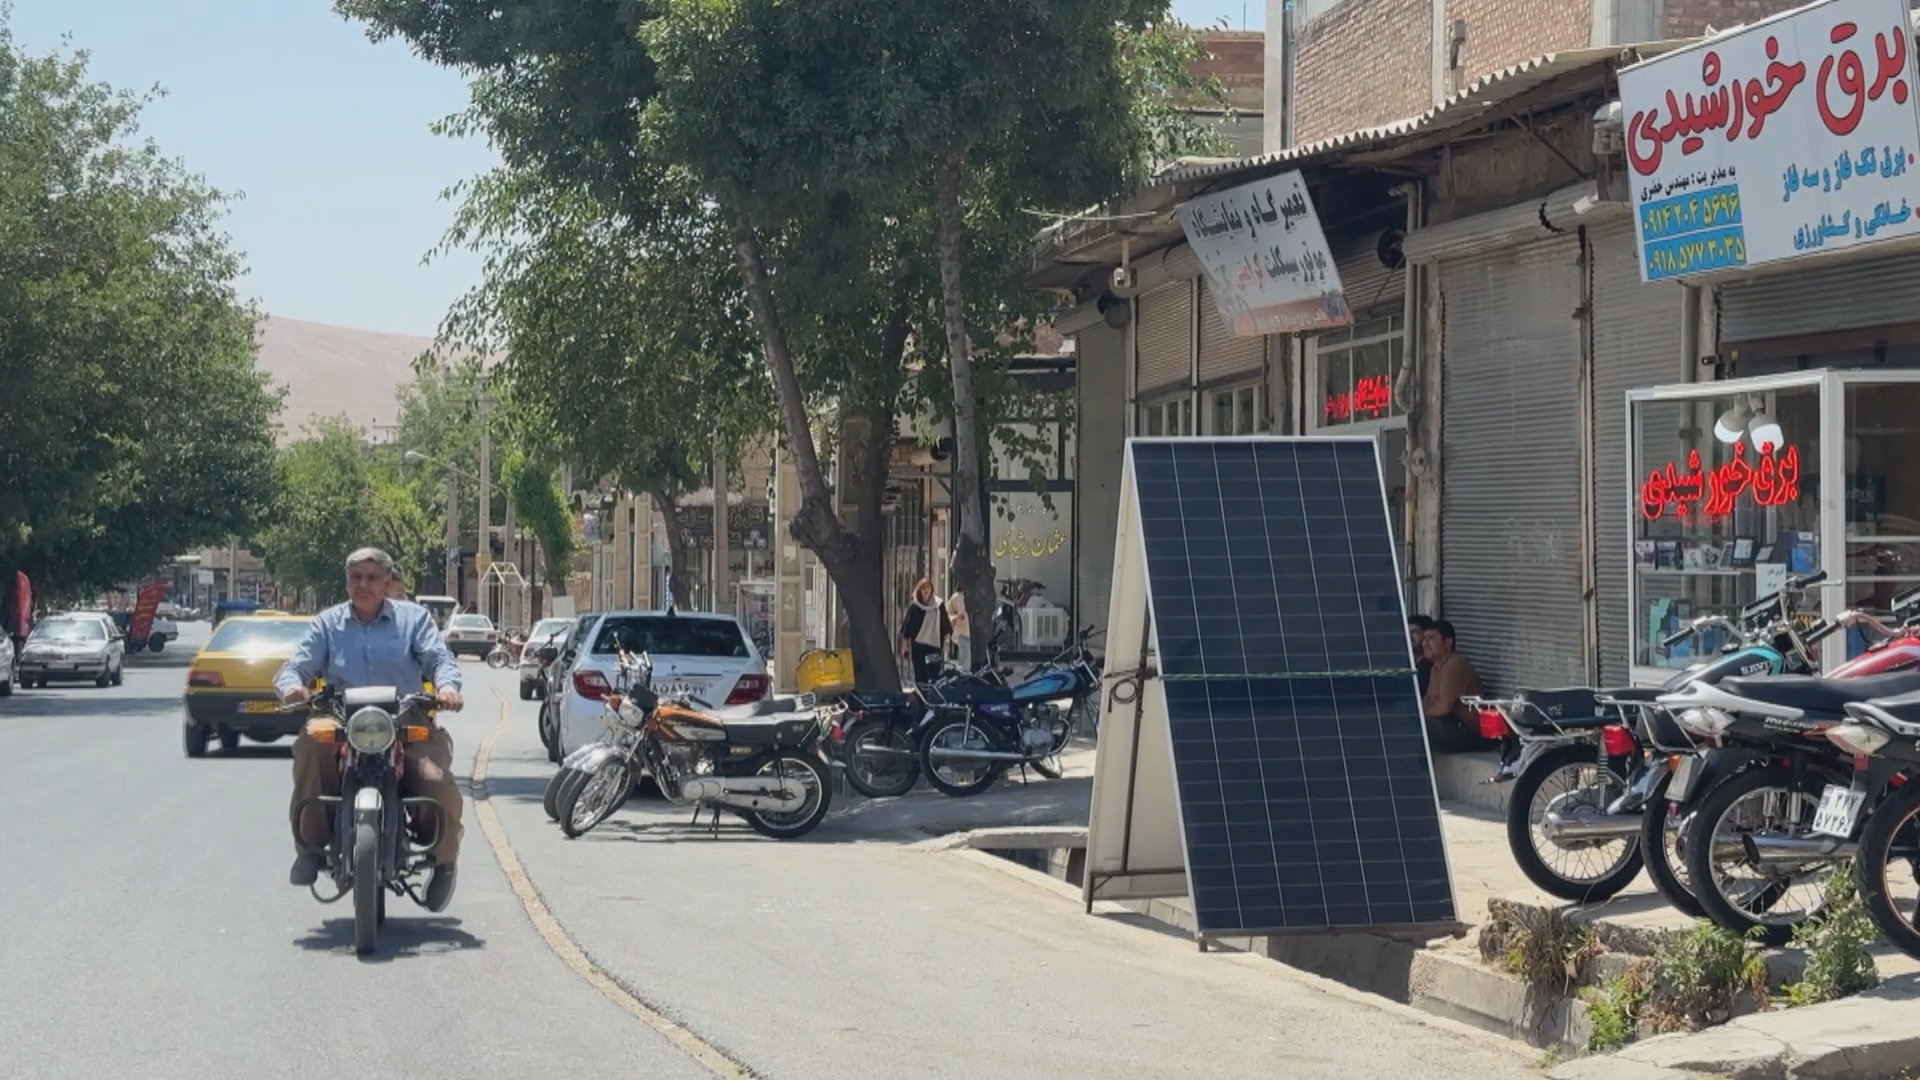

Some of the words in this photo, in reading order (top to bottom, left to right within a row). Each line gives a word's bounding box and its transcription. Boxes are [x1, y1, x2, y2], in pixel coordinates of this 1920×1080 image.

[1816, 22, 1908, 135] برق
[1627, 36, 1806, 176] خورشیدی
[1802, 167, 1819, 188] سه
[1823, 167, 1831, 192] و
[1834, 149, 1853, 191] فاز
[1854, 145, 1877, 176] تک
[1880, 145, 1906, 178] برق
[1665, 175, 1690, 196] مهندس
[1782, 163, 1800, 202] فاز
[1191, 198, 1243, 240] نمایشگاه
[1243, 209, 1256, 239] و
[1793, 209, 1851, 250] کشاورزی
[1855, 217, 1862, 239] و
[1864, 197, 1911, 236] خانگی
[1264, 245, 1299, 282] سیکلت
[1299, 241, 1327, 282] موتور
[1641, 441, 1752, 519] خورشیدی
[1753, 441, 1798, 505] برق
[994, 529, 1030, 560] رشیدی
[1030, 528, 1065, 557] عثمان
